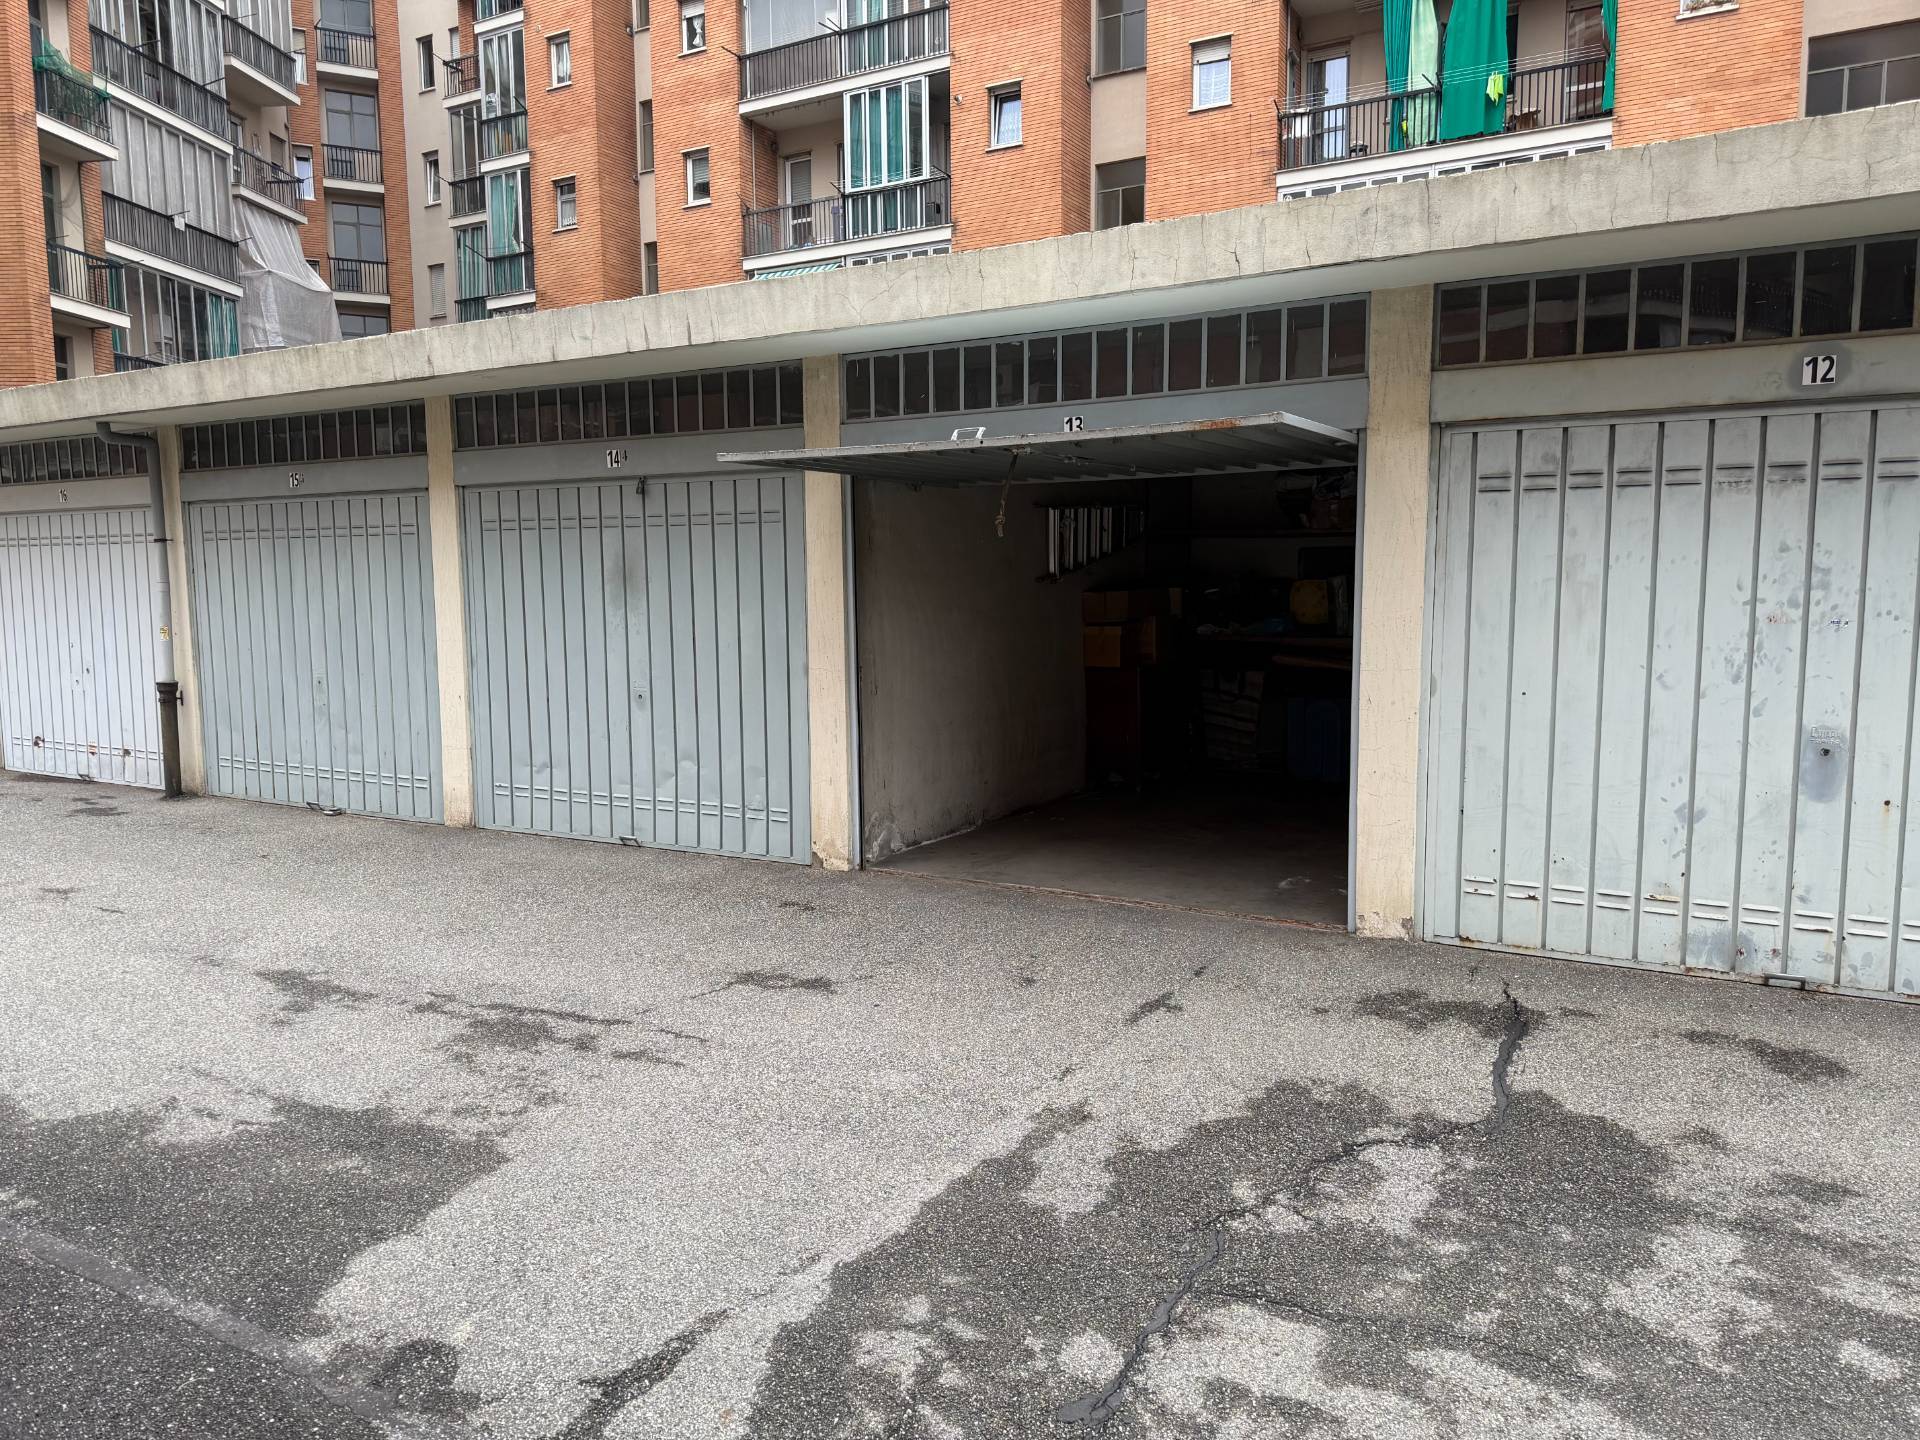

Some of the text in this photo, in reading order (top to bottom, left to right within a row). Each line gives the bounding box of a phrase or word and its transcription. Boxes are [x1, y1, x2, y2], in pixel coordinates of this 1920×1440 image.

[1805, 356, 1835, 384] 12
[1065, 416, 1083, 432] 13
[607, 450, 620, 467] 14
[290, 472, 299, 487] 15
